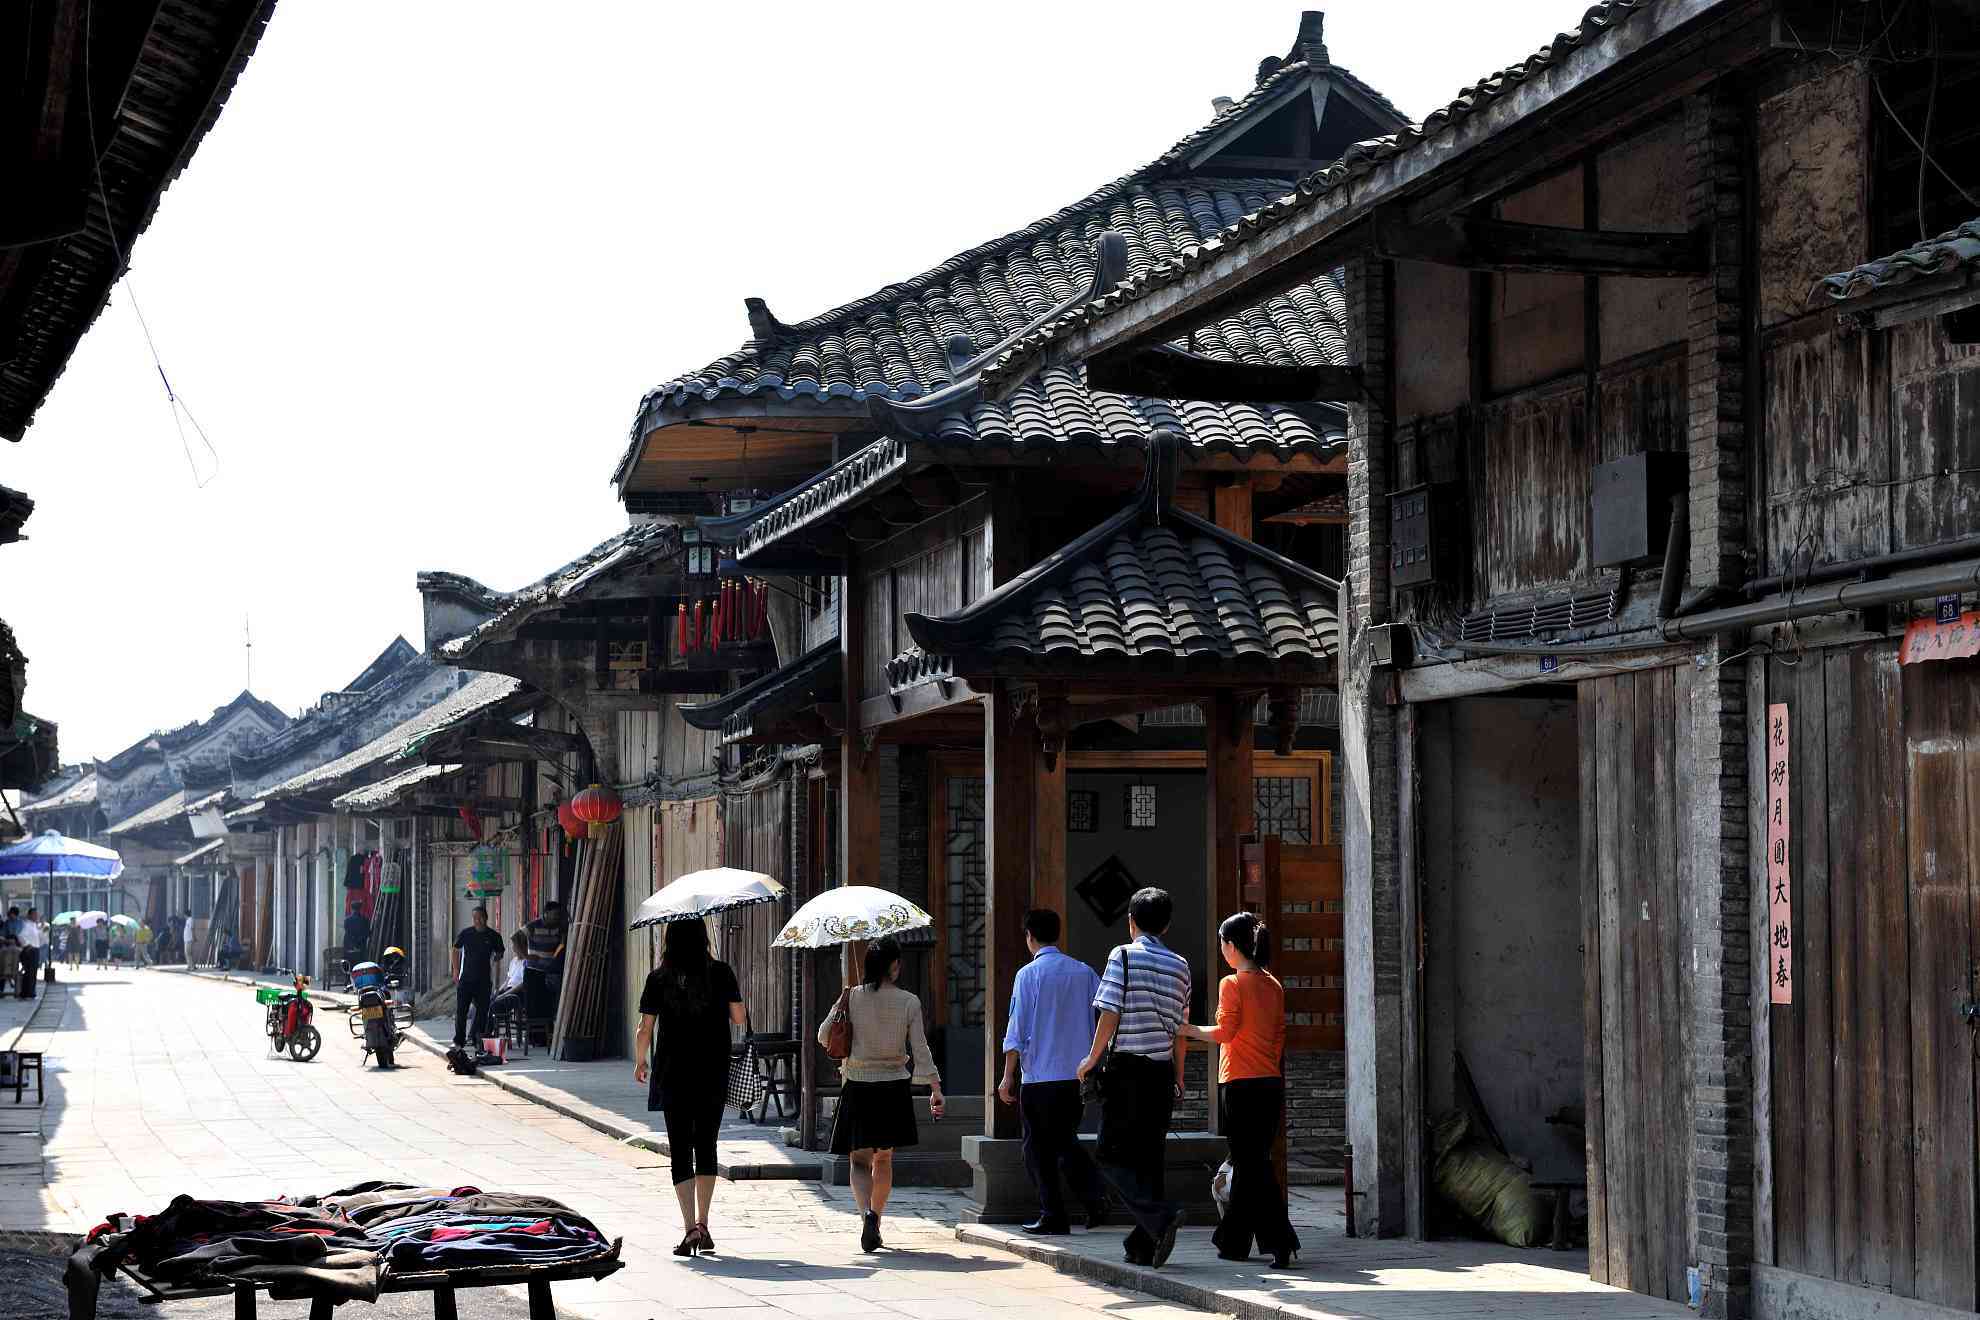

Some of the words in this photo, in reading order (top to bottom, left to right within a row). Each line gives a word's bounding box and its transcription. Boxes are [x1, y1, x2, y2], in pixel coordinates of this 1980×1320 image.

[1943, 604, 1953, 618] 68
[1771, 716, 1789, 988] 花好月圓大地春
